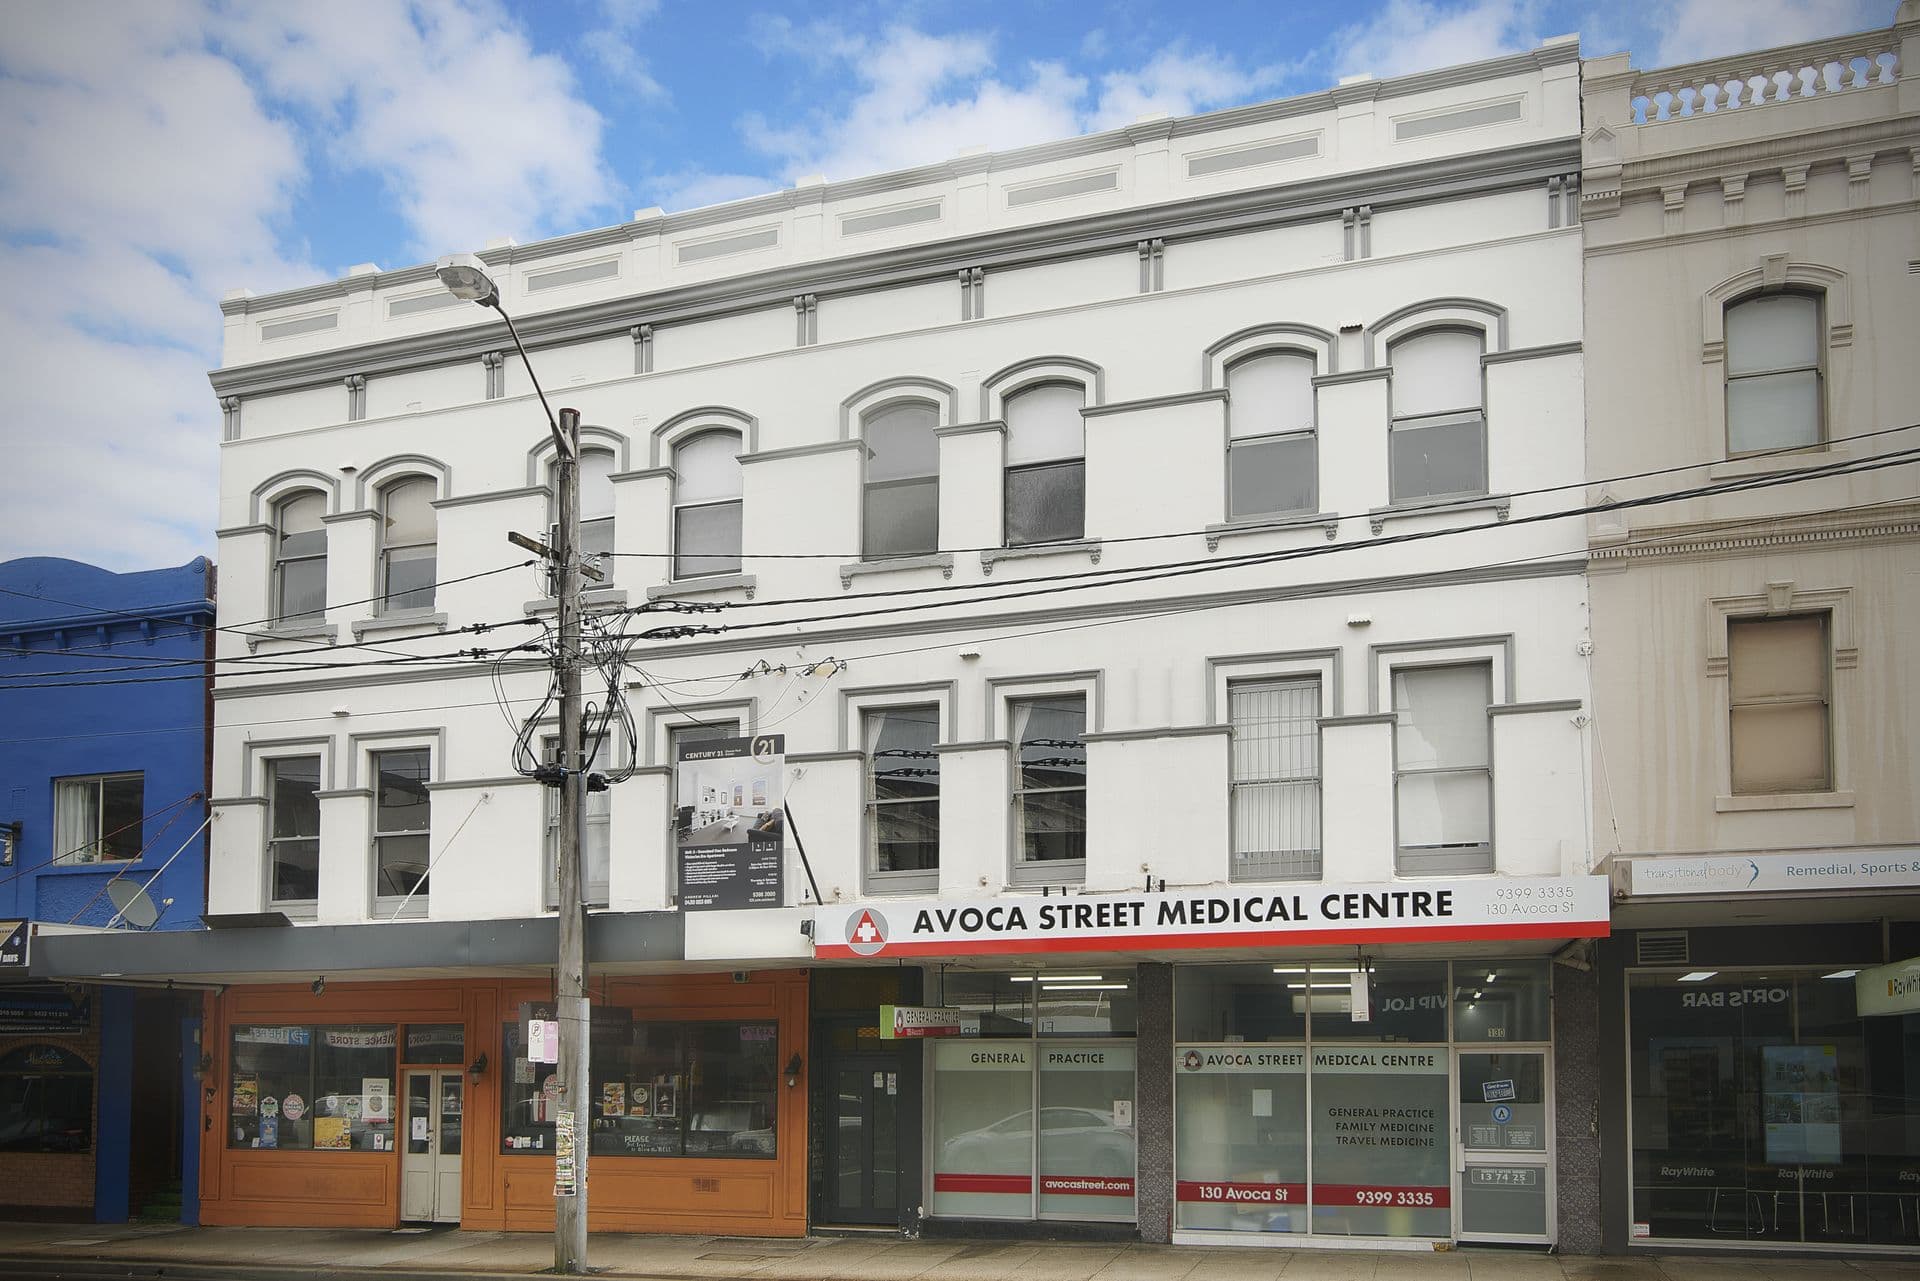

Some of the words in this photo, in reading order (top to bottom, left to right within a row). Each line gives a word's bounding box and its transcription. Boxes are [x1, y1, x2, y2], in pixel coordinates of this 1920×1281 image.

[685, 751, 716, 760] CENTURY
[717, 750, 724, 758] 21
[1786, 863, 1856, 877] Remedial,
[1861, 862, 1907, 876] Sports
[1497, 888, 1532, 899] 9399
[1538, 886, 1574, 898] 3335
[913, 906, 1028, 933] AVOCA
[1039, 902, 1145, 930] STREET
[1157, 896, 1308, 926] MEDICAL
[1320, 890, 1453, 920] CENTRE
[1486, 903, 1507, 915] 130
[1512, 903, 1558, 914] Avoca
[1562, 901, 1574, 913] St
[1894, 972, 1920, 998] RayWhi
[906, 1011, 932, 1024] GENERAL
[934, 1010, 960, 1023] PRACTICE
[1488, 1028, 1505, 1037] 130
[971, 1053, 1026, 1064] GENERAL
[1048, 1053, 1104, 1064] PRACTICE
[1206, 1054, 1253, 1066] AVOCA
[1257, 1054, 1303, 1066] STREET
[1315, 1055, 1377, 1066] MEDICAL
[1382, 1054, 1434, 1067] CENTRE
[1328, 1108, 1379, 1117] GENERAL
[1382, 1109, 1434, 1118] PRACTICE
[1335, 1122, 1376, 1131] FAMILY
[1380, 1123, 1434, 1132] MEDICINE
[624, 1135, 650, 1143] PLEASE
[1336, 1136, 1376, 1145] TRAVEL
[1380, 1137, 1434, 1146] MEDICINE
[1480, 1173, 1493, 1181] 13
[1495, 1173, 1508, 1182] 74
[1512, 1174, 1526, 1182] 25
[1661, 1166, 1715, 1178] RayWhite
[1777, 1168, 1834, 1180] RayWhite
[1045, 1180, 1130, 1190] avocastreet.com
[1199, 1186, 1222, 1199] 130
[1225, 1188, 1271, 1200] Avoca
[1275, 1188, 1288, 1201] St
[1356, 1191, 1393, 1204] 9399
[1397, 1192, 1434, 1205] 3335
